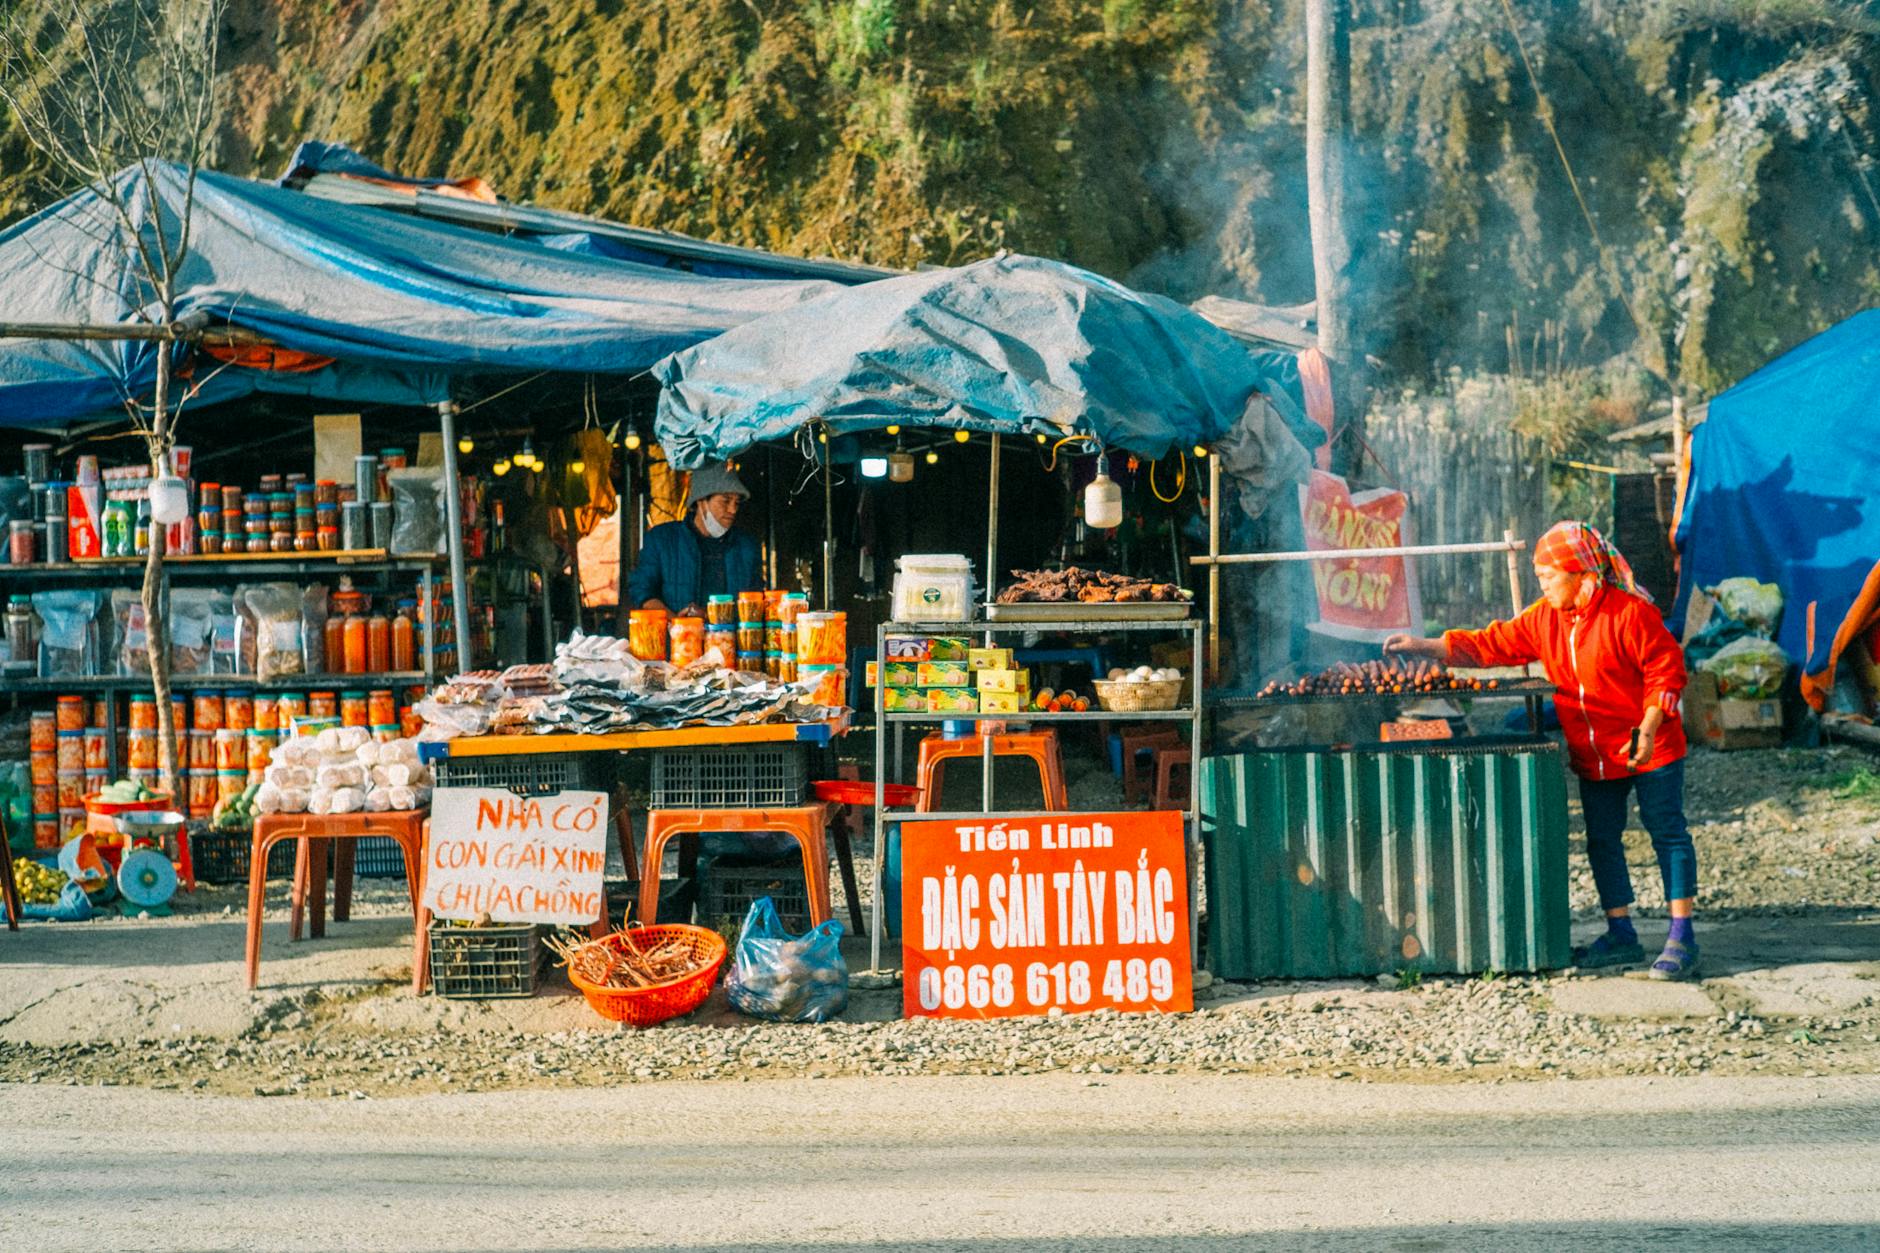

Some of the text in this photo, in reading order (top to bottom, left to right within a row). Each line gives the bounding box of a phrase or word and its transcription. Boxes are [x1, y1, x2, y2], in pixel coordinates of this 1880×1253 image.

[552, 796, 603, 833] CÓ
[435, 840, 488, 869] CON
[494, 838, 546, 872] GÁI
[955, 822, 1114, 852] Tiến Linh
[436, 878, 600, 916] CHƯA CHỒNG
[921, 848, 1175, 961] ĐẶC SẢN TÂY BẮC
[919, 957, 1173, 1010] 0868 618 489
